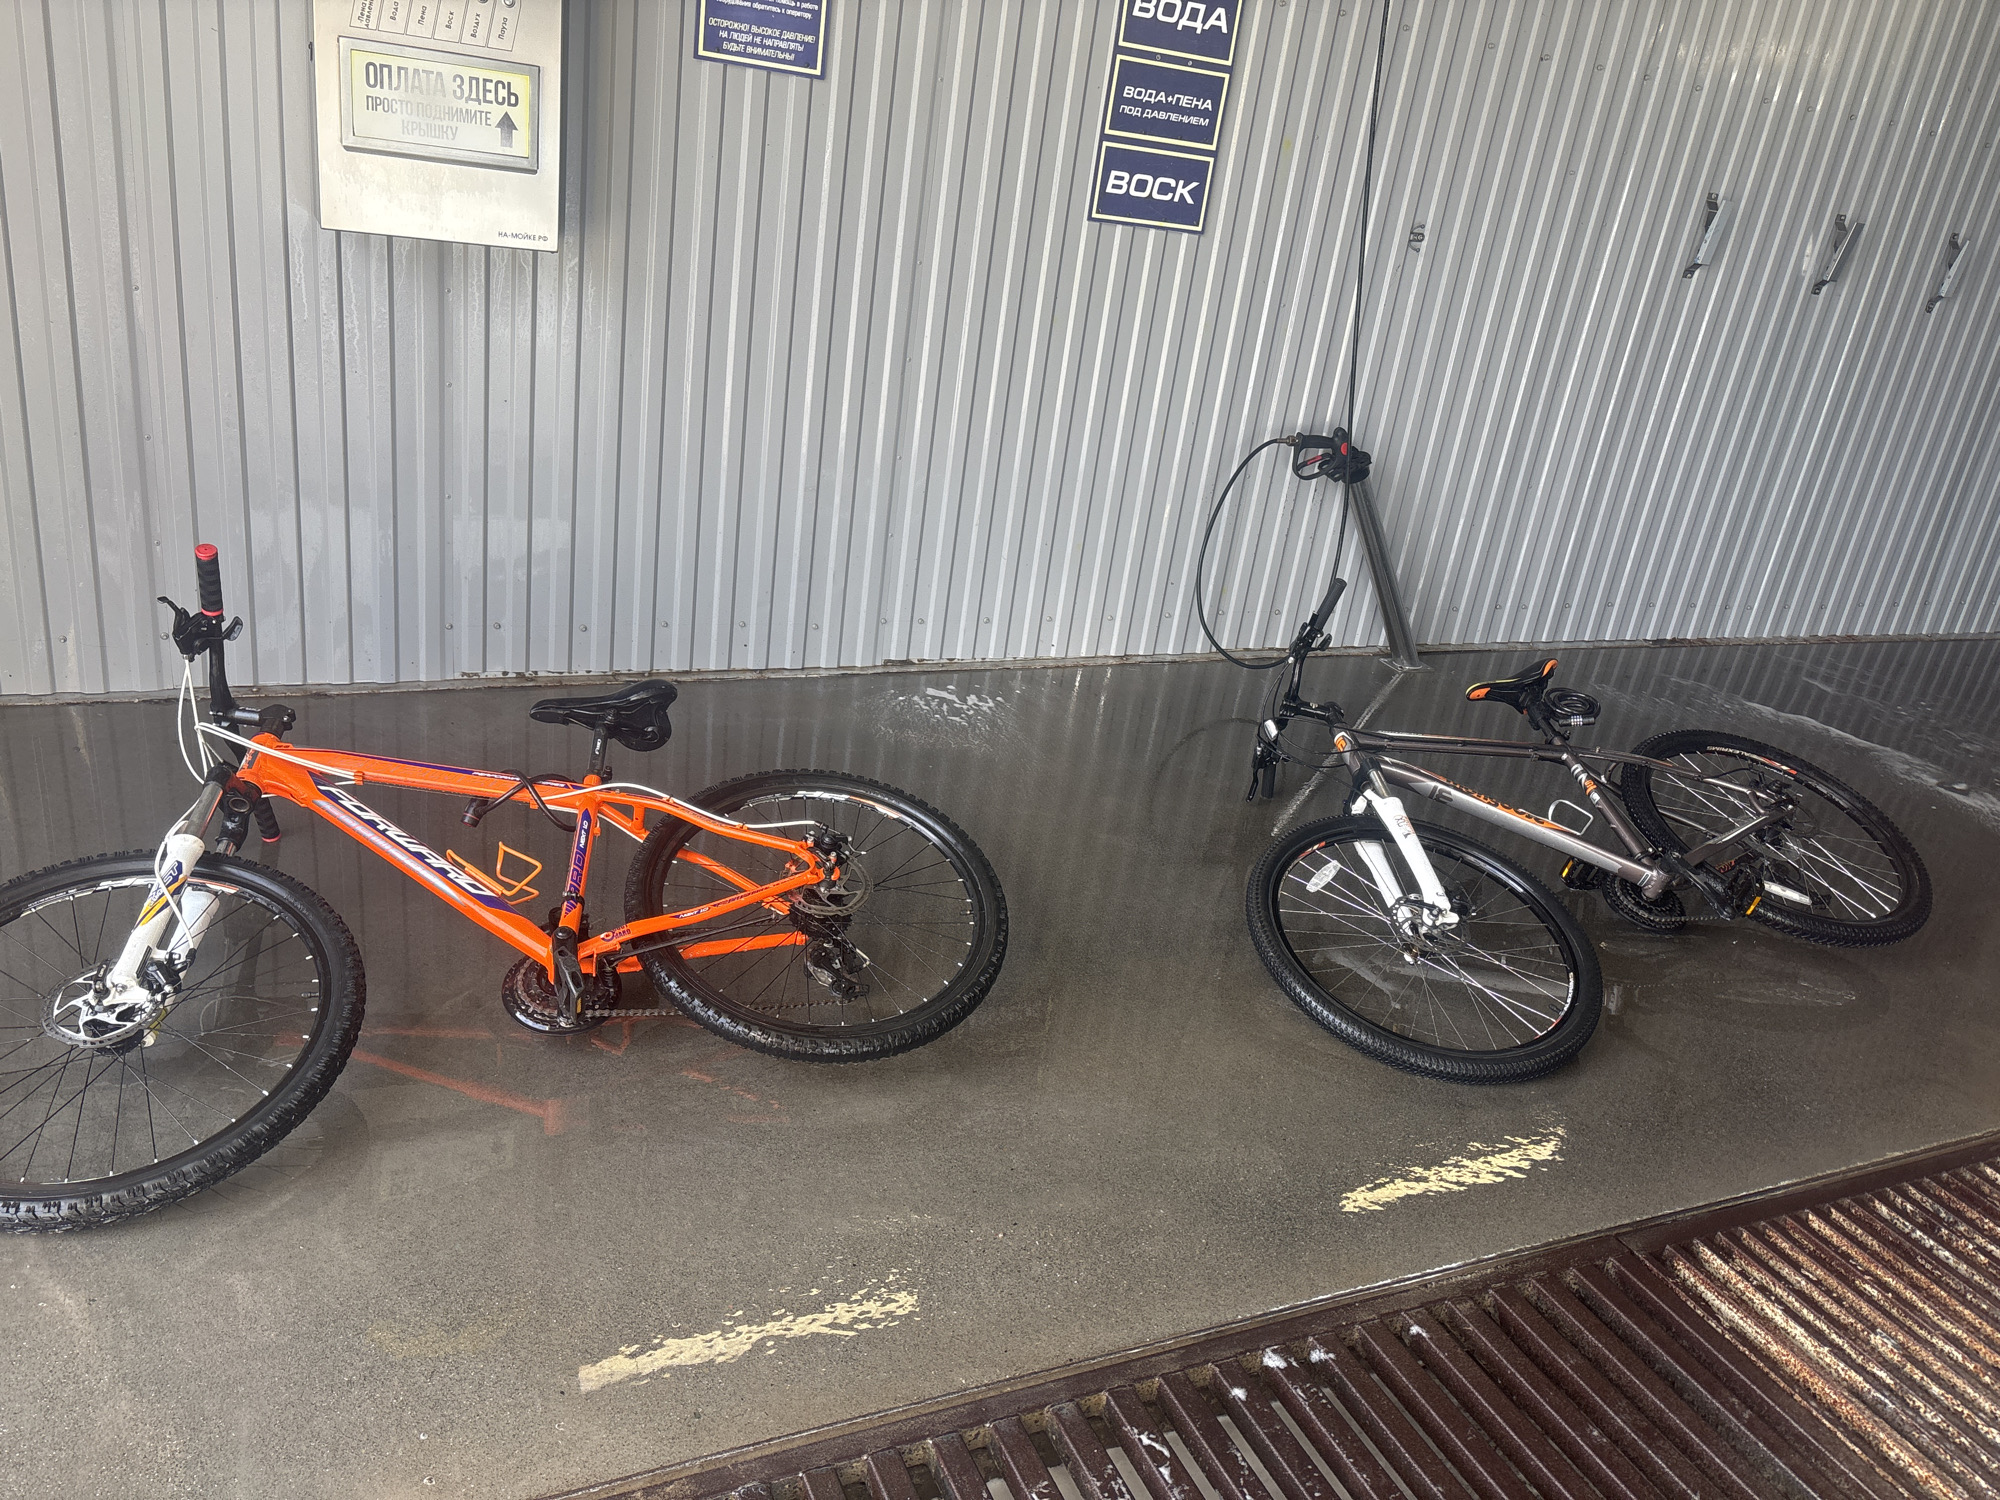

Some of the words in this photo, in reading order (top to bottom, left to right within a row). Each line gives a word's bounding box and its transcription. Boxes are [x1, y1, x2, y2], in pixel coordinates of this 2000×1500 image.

[390, 1, 399, 21] Вода
[418, 5, 427, 25] Пена
[445, 10, 454, 29] Воск
[1132, 0, 1228, 34] ВОДА
[470, 13, 481, 38] Воздух
[498, 17, 508, 40] Пауза
[708, 17, 749, 32] ОСТОРОЖНО!
[750, 23, 781, 38] ВЫСОКОЕ
[781, 30, 816, 44] ДАВЛЕНИЕ!
[719, 30, 728, 39] НА
[729, 31, 753, 44] ЛЮДЕЙ
[753, 36, 762, 44] НЕ
[763, 37, 804, 52] НАПРАВЛЯТЬ!
[722, 41, 745, 53] БУДЬТЕ
[365, 61, 446, 99] ОПЛАТА
[452, 73, 519, 108] ЗДЕСЬ
[1122, 85, 1213, 112] ВОДА+ПЕНА
[365, 94, 414, 116] ПРОСТО
[416, 101, 492, 127] ПОДНИМИТЕ
[1119, 105, 1142, 118] ПОД
[1143, 108, 1210, 127] ДАВЛЕНИЕМ
[401, 119, 459, 141] КРЫШКУ
[1105, 170, 1200, 205] ВОСК
[498, 230, 549, 242] НА-МОЙКЕ.РФ
[317, 785, 502, 898] FORWARD
